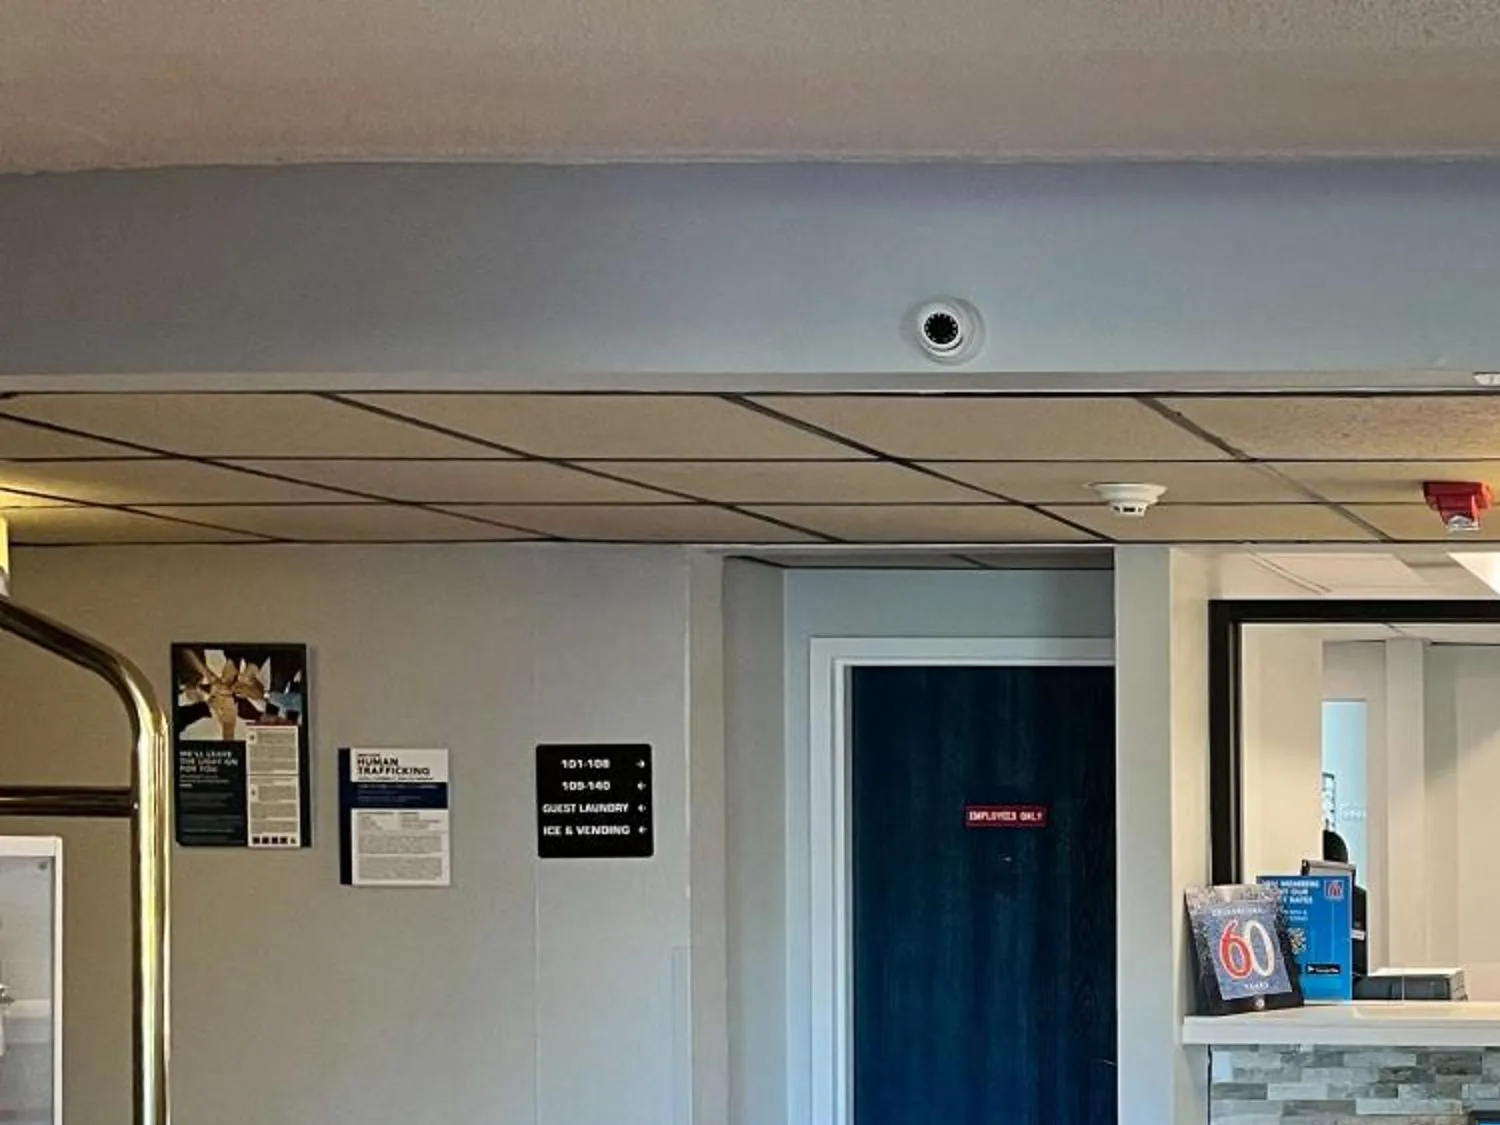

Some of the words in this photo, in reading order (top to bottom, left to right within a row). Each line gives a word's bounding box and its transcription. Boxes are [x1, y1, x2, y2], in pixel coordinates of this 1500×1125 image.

[357, 758, 399, 766] HUMAN
[357, 767, 431, 775] TRAFFICKING
[542, 803, 577, 813] GUEST
[579, 803, 629, 813] LAUNDRY
[969, 811, 1017, 821] EMPLOYEES
[1019, 811, 1043, 821] ONLY
[543, 825, 562, 835] ICE
[576, 825, 631, 835] VENDING
[1219, 918, 1275, 979] 60
